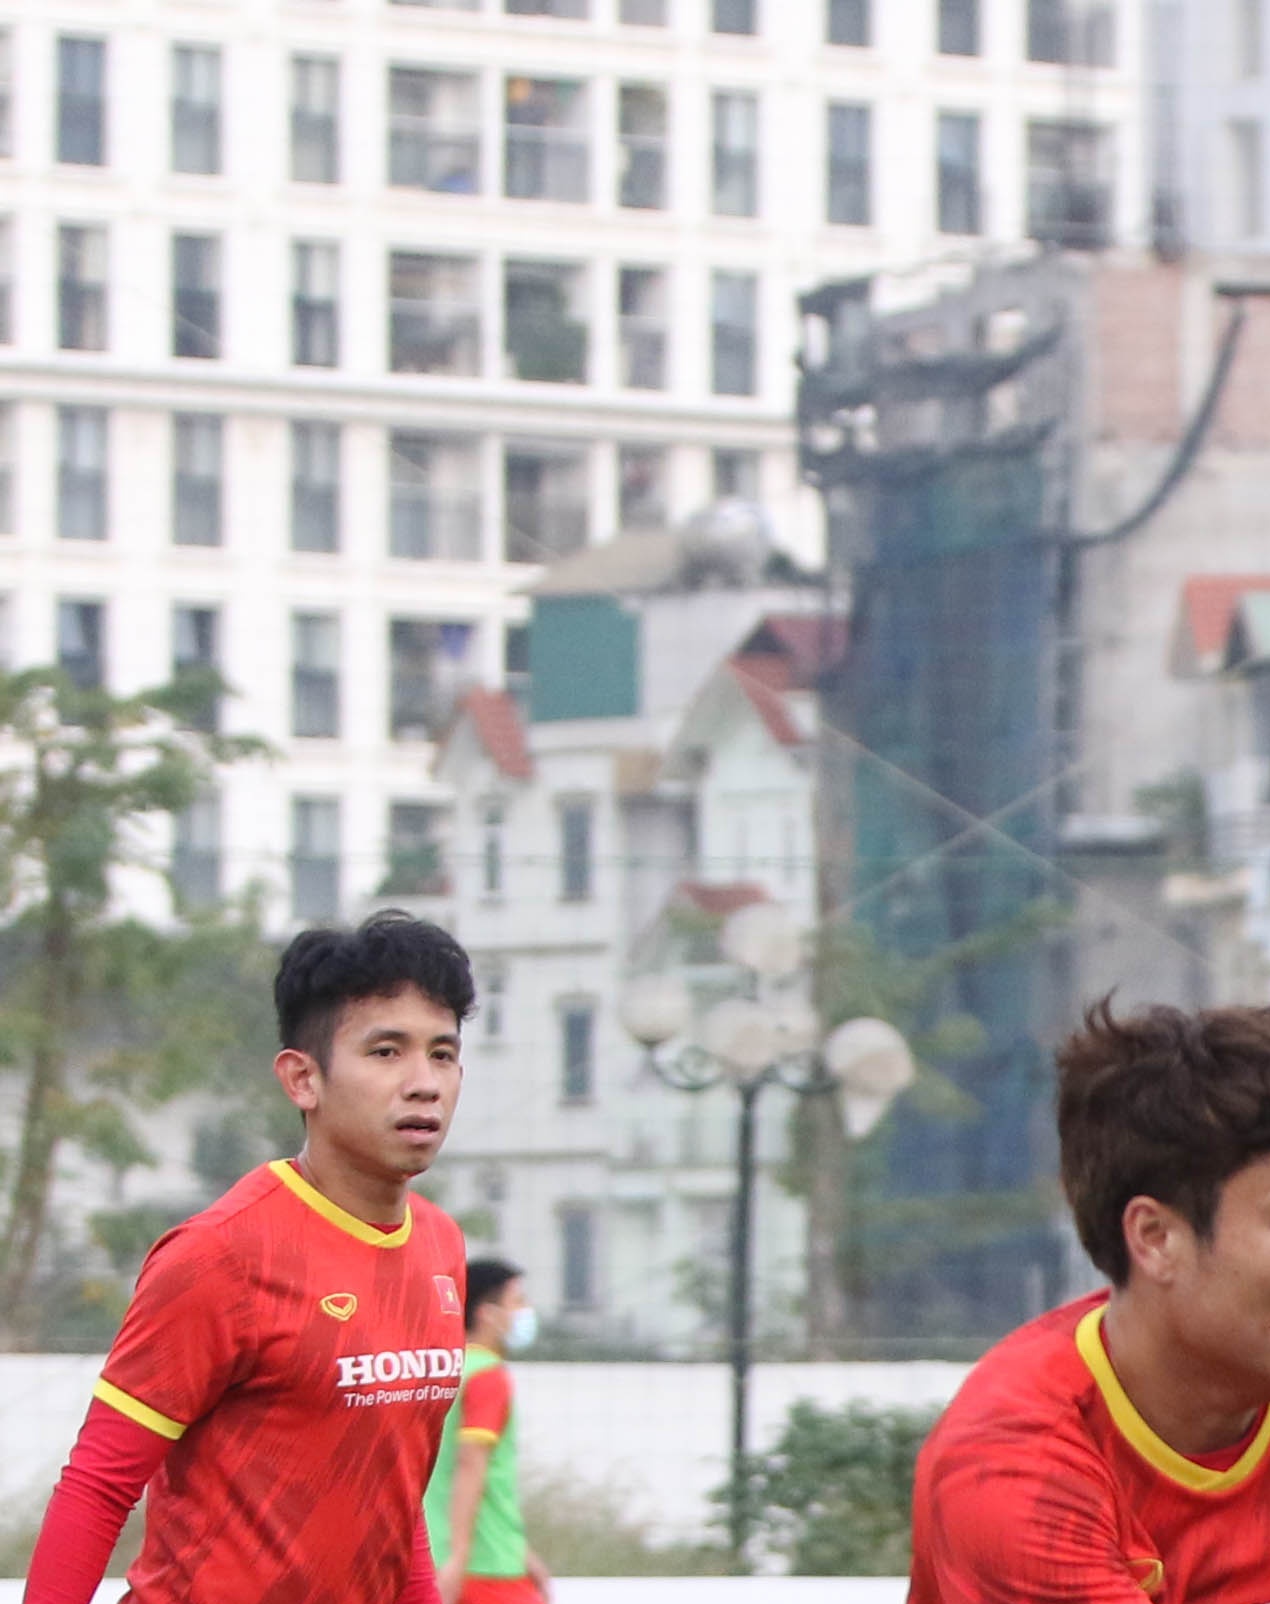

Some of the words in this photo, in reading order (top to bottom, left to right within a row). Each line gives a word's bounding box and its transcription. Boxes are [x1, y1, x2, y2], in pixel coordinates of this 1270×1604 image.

[344, 1393, 374, 1407] The
[377, 1388, 413, 1404] Power
[415, 1385, 429, 1401] of
